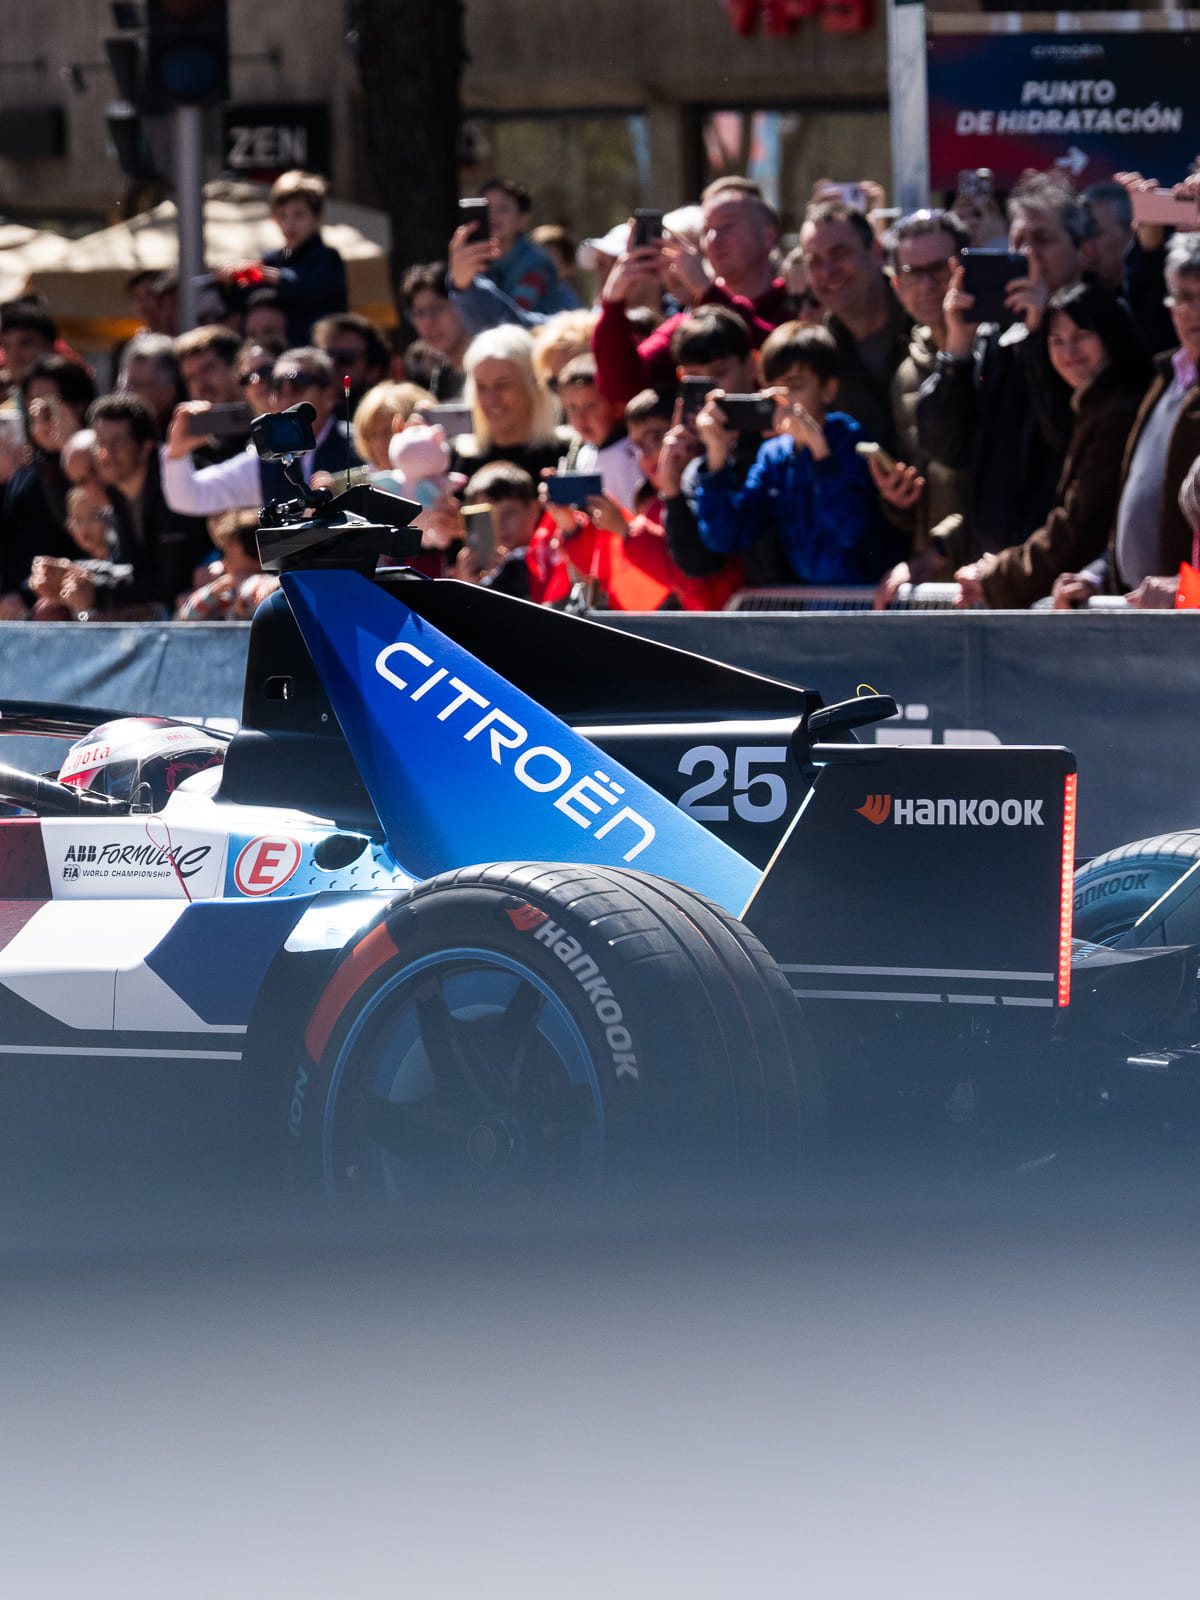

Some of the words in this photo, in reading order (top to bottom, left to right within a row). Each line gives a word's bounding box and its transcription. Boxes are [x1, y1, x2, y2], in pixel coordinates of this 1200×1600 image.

[1021, 80, 1115, 105] PUNTO
[956, 111, 993, 135] DE
[996, 103, 1182, 134] HIDRATACIÓN
[229, 127, 307, 168] ZEN
[374, 641, 657, 863] CITROËN
[677, 745, 788, 823] 25
[64, 845, 97, 862] ABB
[97, 843, 183, 865] FORMULA
[248, 842, 287, 884] E
[82, 869, 109, 877] WORLD
[111, 870, 172, 879] CHAMPIONSHIP
